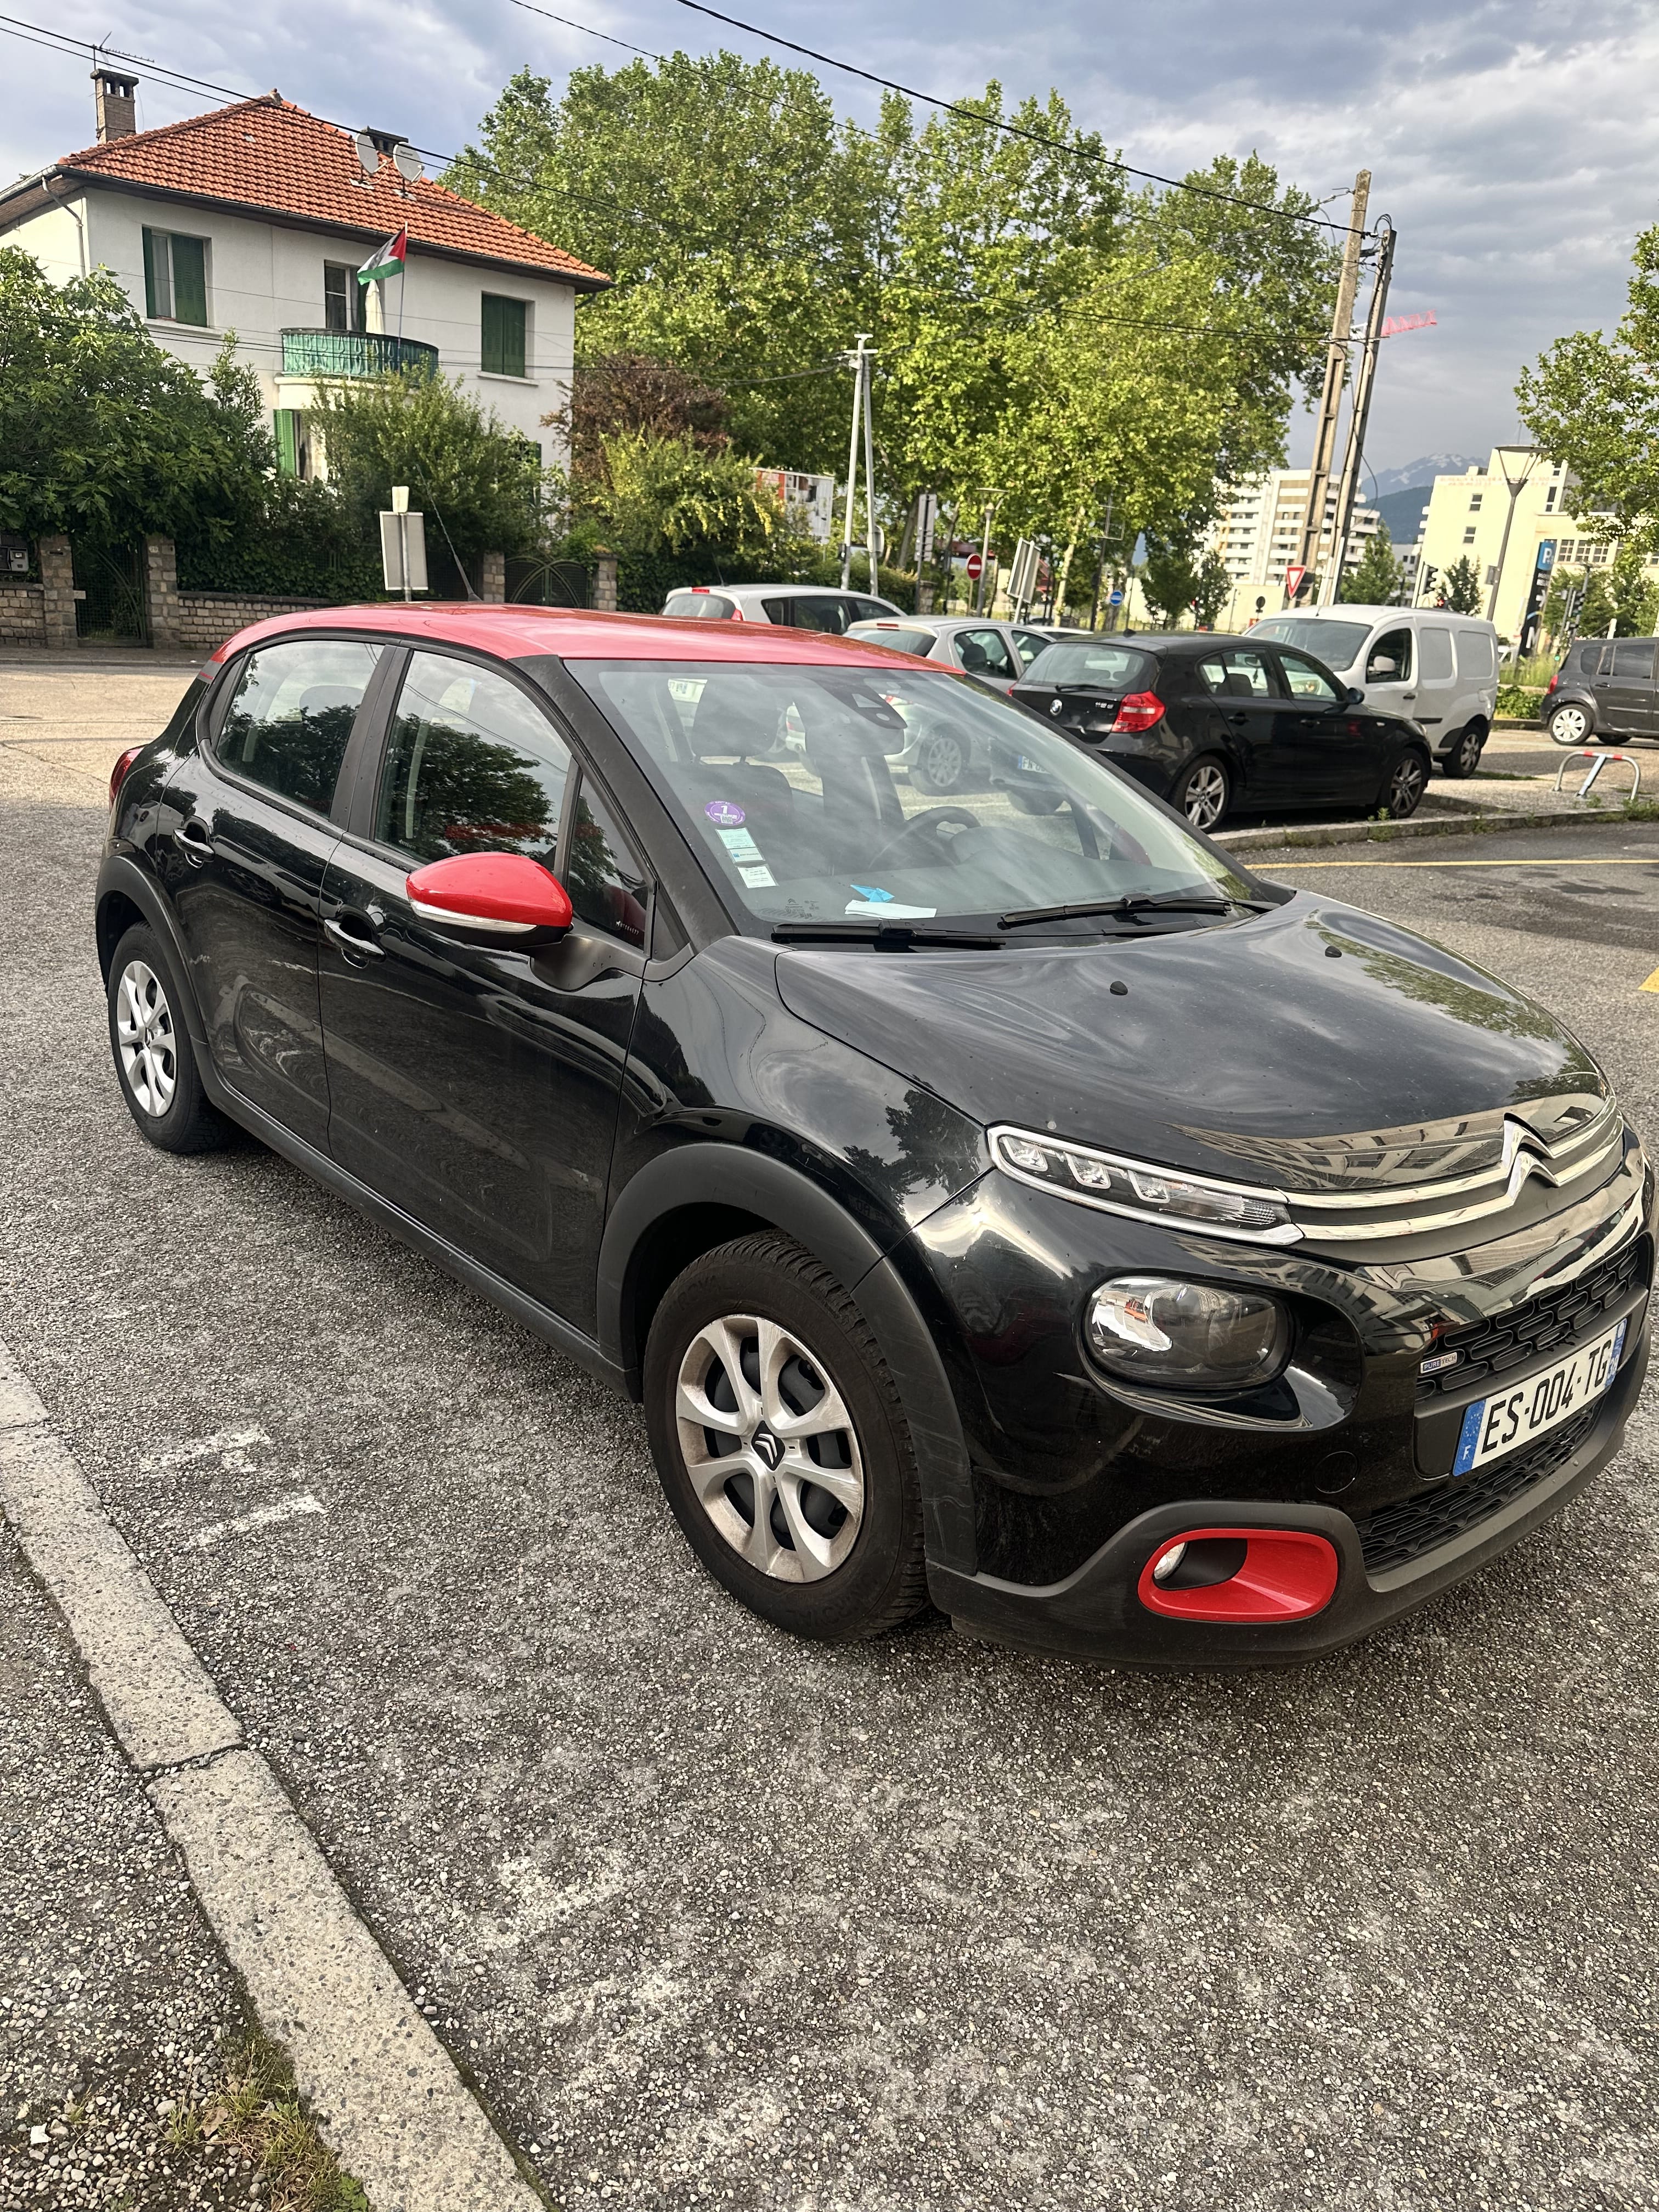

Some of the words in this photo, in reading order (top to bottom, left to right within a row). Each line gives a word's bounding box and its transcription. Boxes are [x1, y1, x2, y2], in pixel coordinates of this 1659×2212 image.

[721, 805, 728, 814] 1
[1481, 1340, 1612, 1454] ES-004-TG
[1462, 1444, 1471, 1460] F
